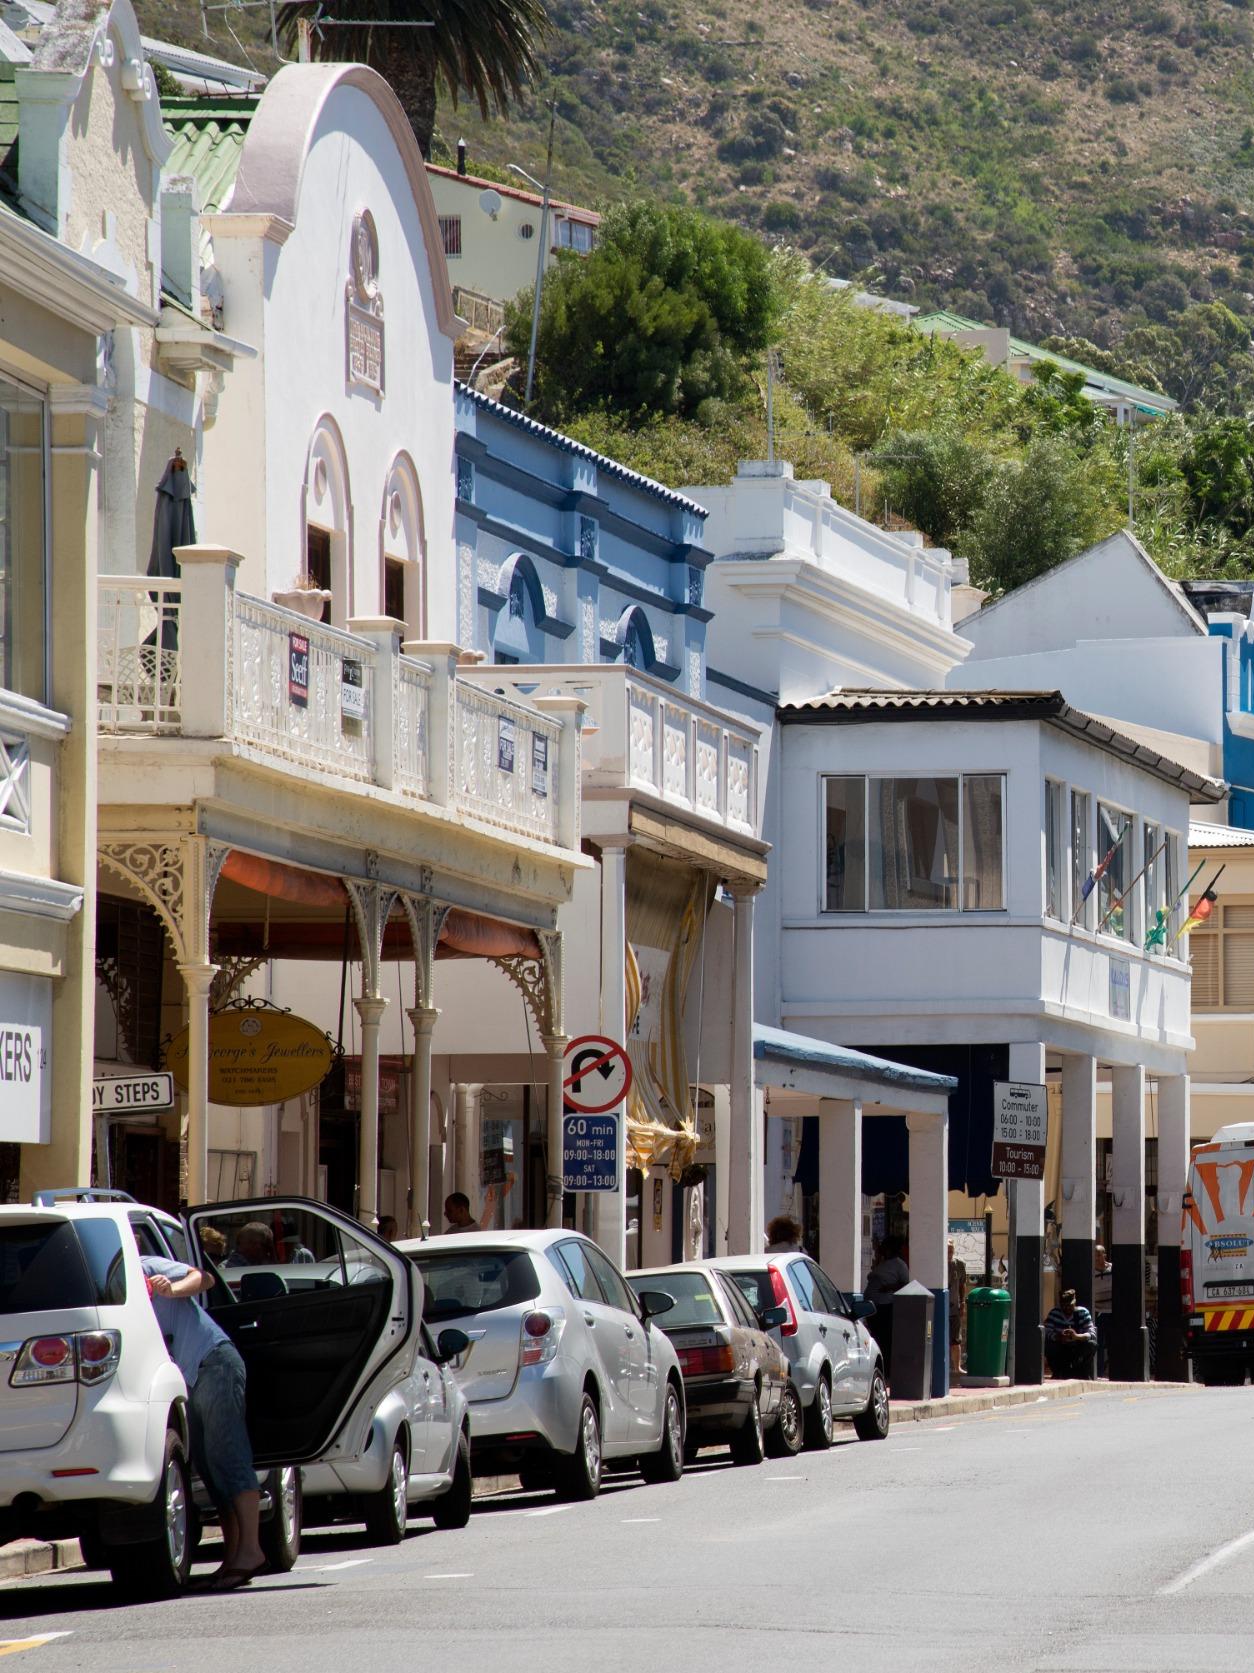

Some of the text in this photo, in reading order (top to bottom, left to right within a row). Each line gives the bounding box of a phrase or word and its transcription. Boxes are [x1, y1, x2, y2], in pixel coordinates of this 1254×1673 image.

[291, 652, 308, 686] Seeff
[260, 1041, 325, 1065] Jewellers
[115, 1081, 160, 1104] STEPS
[1001, 1099, 1039, 1113] Commuter
[567, 1119, 613, 1135] 60 min
[1000, 1113, 1018, 1126] 06:00
[1025, 1116, 1041, 1127] 10:00
[1001, 1127, 1017, 1139] 15:00
[1024, 1129, 1041, 1141] 18:00
[576, 1139, 604, 1147] MON-FRI
[564, 1149, 616, 1161] 09:00-18:00
[1006, 1146, 1034, 1161] Tourism
[583, 1164, 596, 1173] SAT
[999, 1160, 1016, 1173] 10:00
[1023, 1163, 1040, 1175] 15:00
[564, 1175, 616, 1186] 09:00-13:00
[1207, 1239, 1251, 1248] ABSOLUT
[1211, 1288, 1220, 1297] CA
